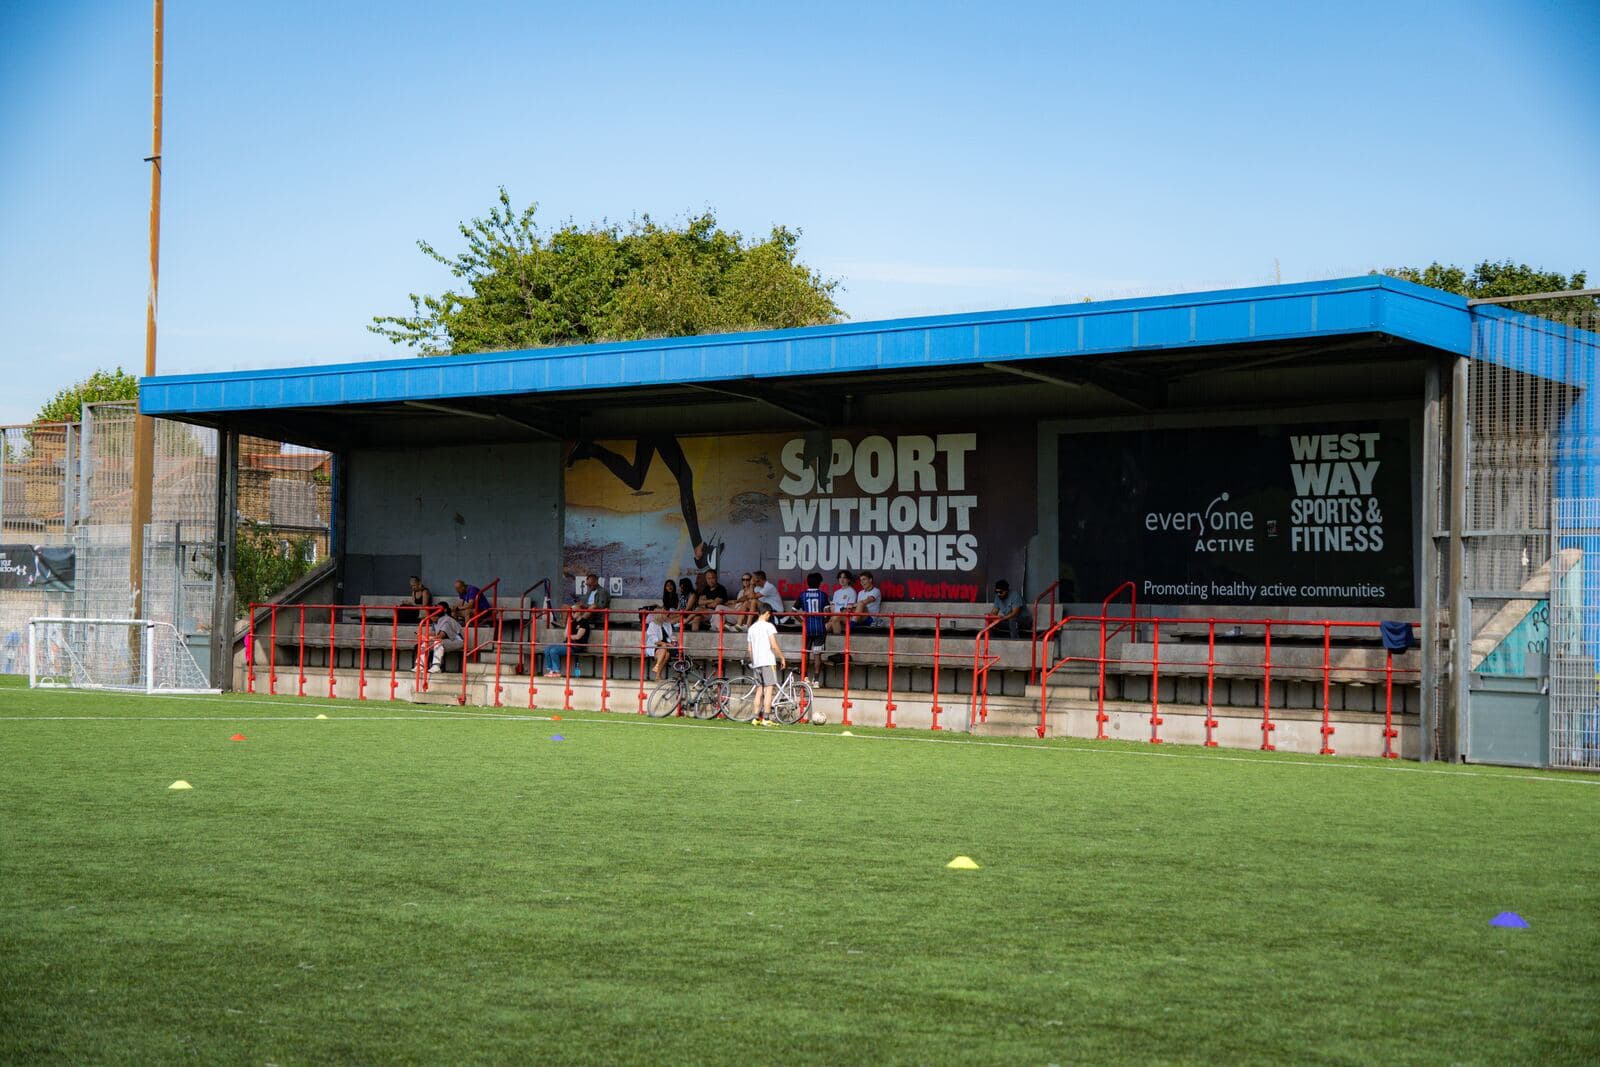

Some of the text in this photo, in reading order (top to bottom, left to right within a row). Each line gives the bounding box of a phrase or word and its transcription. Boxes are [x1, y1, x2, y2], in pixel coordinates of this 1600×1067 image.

[1290, 433, 1381, 461] WEST
[779, 433, 977, 496] SPORT
[1290, 461, 1381, 497] WAY
[778, 495, 978, 533] WITHOUT
[1145, 498, 1254, 536] everyone
[1291, 497, 1383, 525] SPORTS &
[778, 533, 978, 571] BOUNDARIES
[1194, 539, 1255, 552] ACTIVE
[1291, 525, 1384, 552] FITNESS
[907, 579, 979, 603] Westway
[1144, 580, 1385, 600] Promoting healthy active communities
[806, 598, 819, 613] 10
